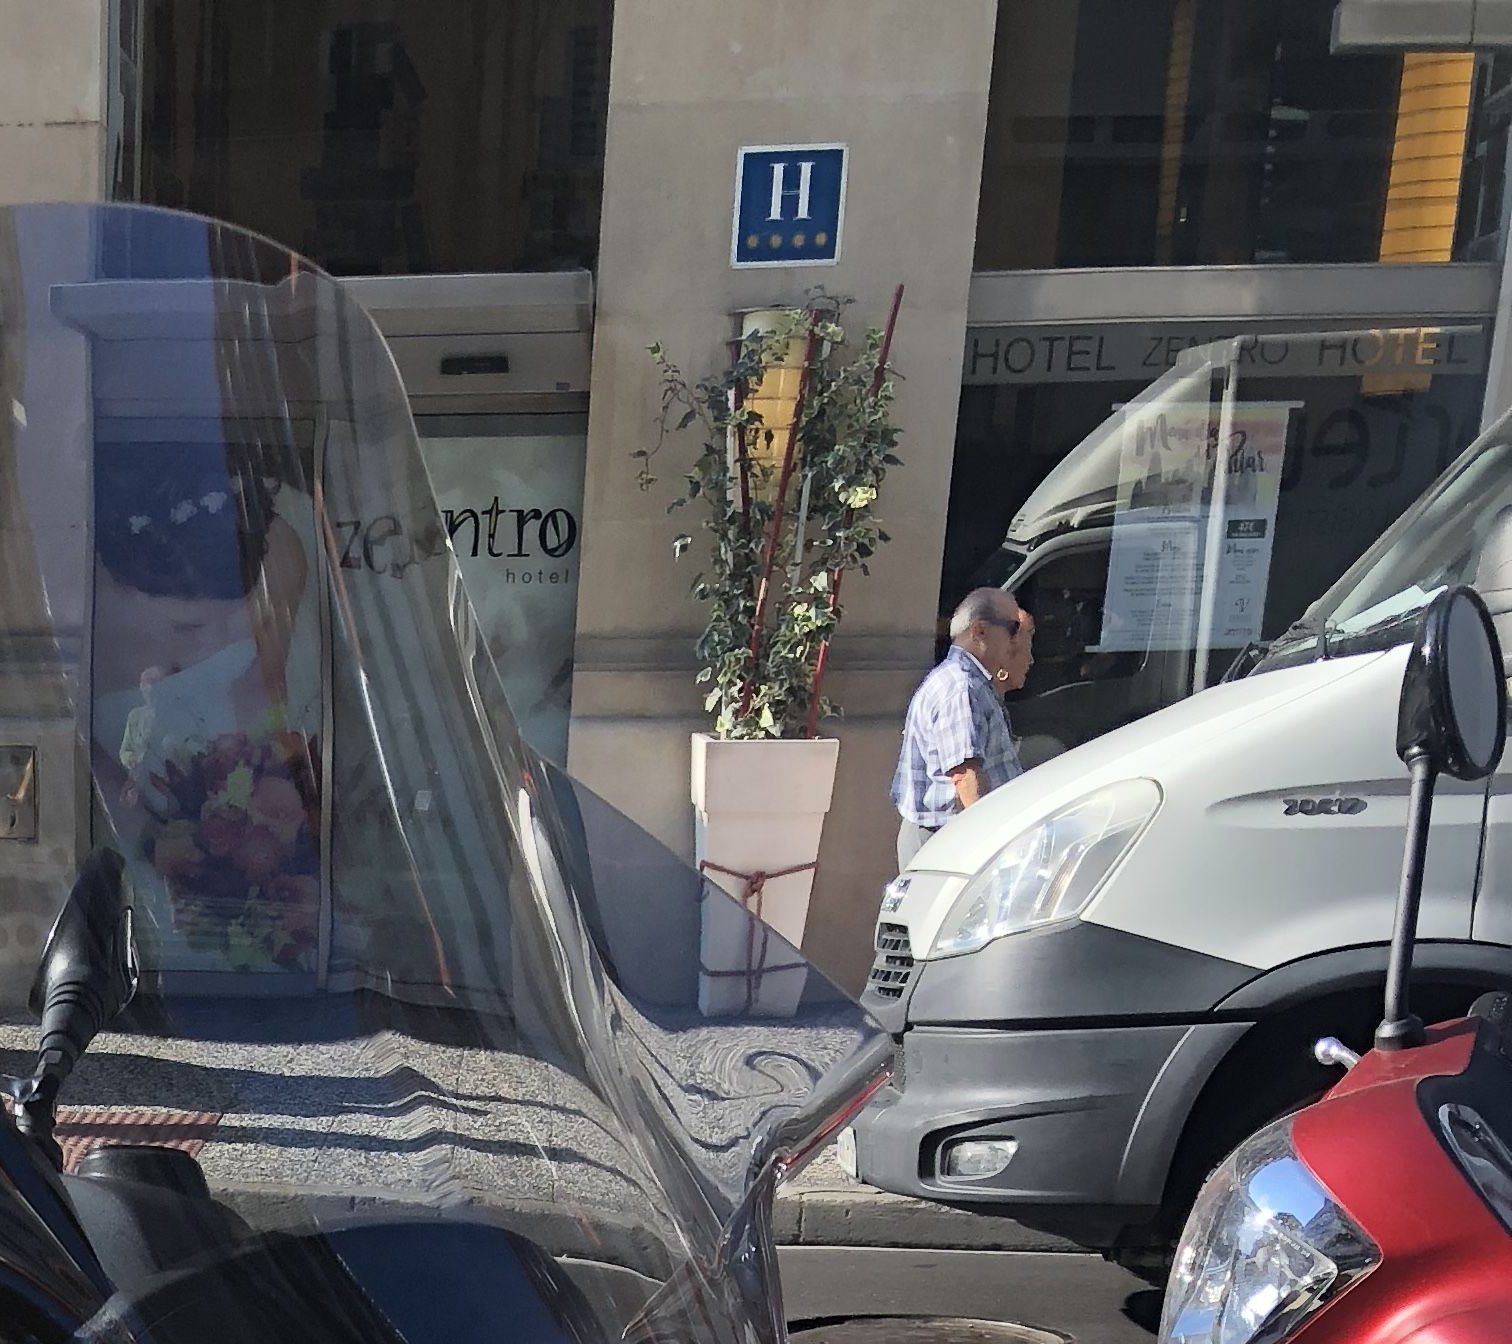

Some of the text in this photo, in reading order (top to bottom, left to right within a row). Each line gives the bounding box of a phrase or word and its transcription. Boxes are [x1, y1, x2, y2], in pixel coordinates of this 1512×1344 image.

[765, 161, 816, 221] H
[970, 335, 1117, 375] HOTEL
[1317, 326, 1469, 367] HOTEL
[505, 567, 570, 584] hotel
